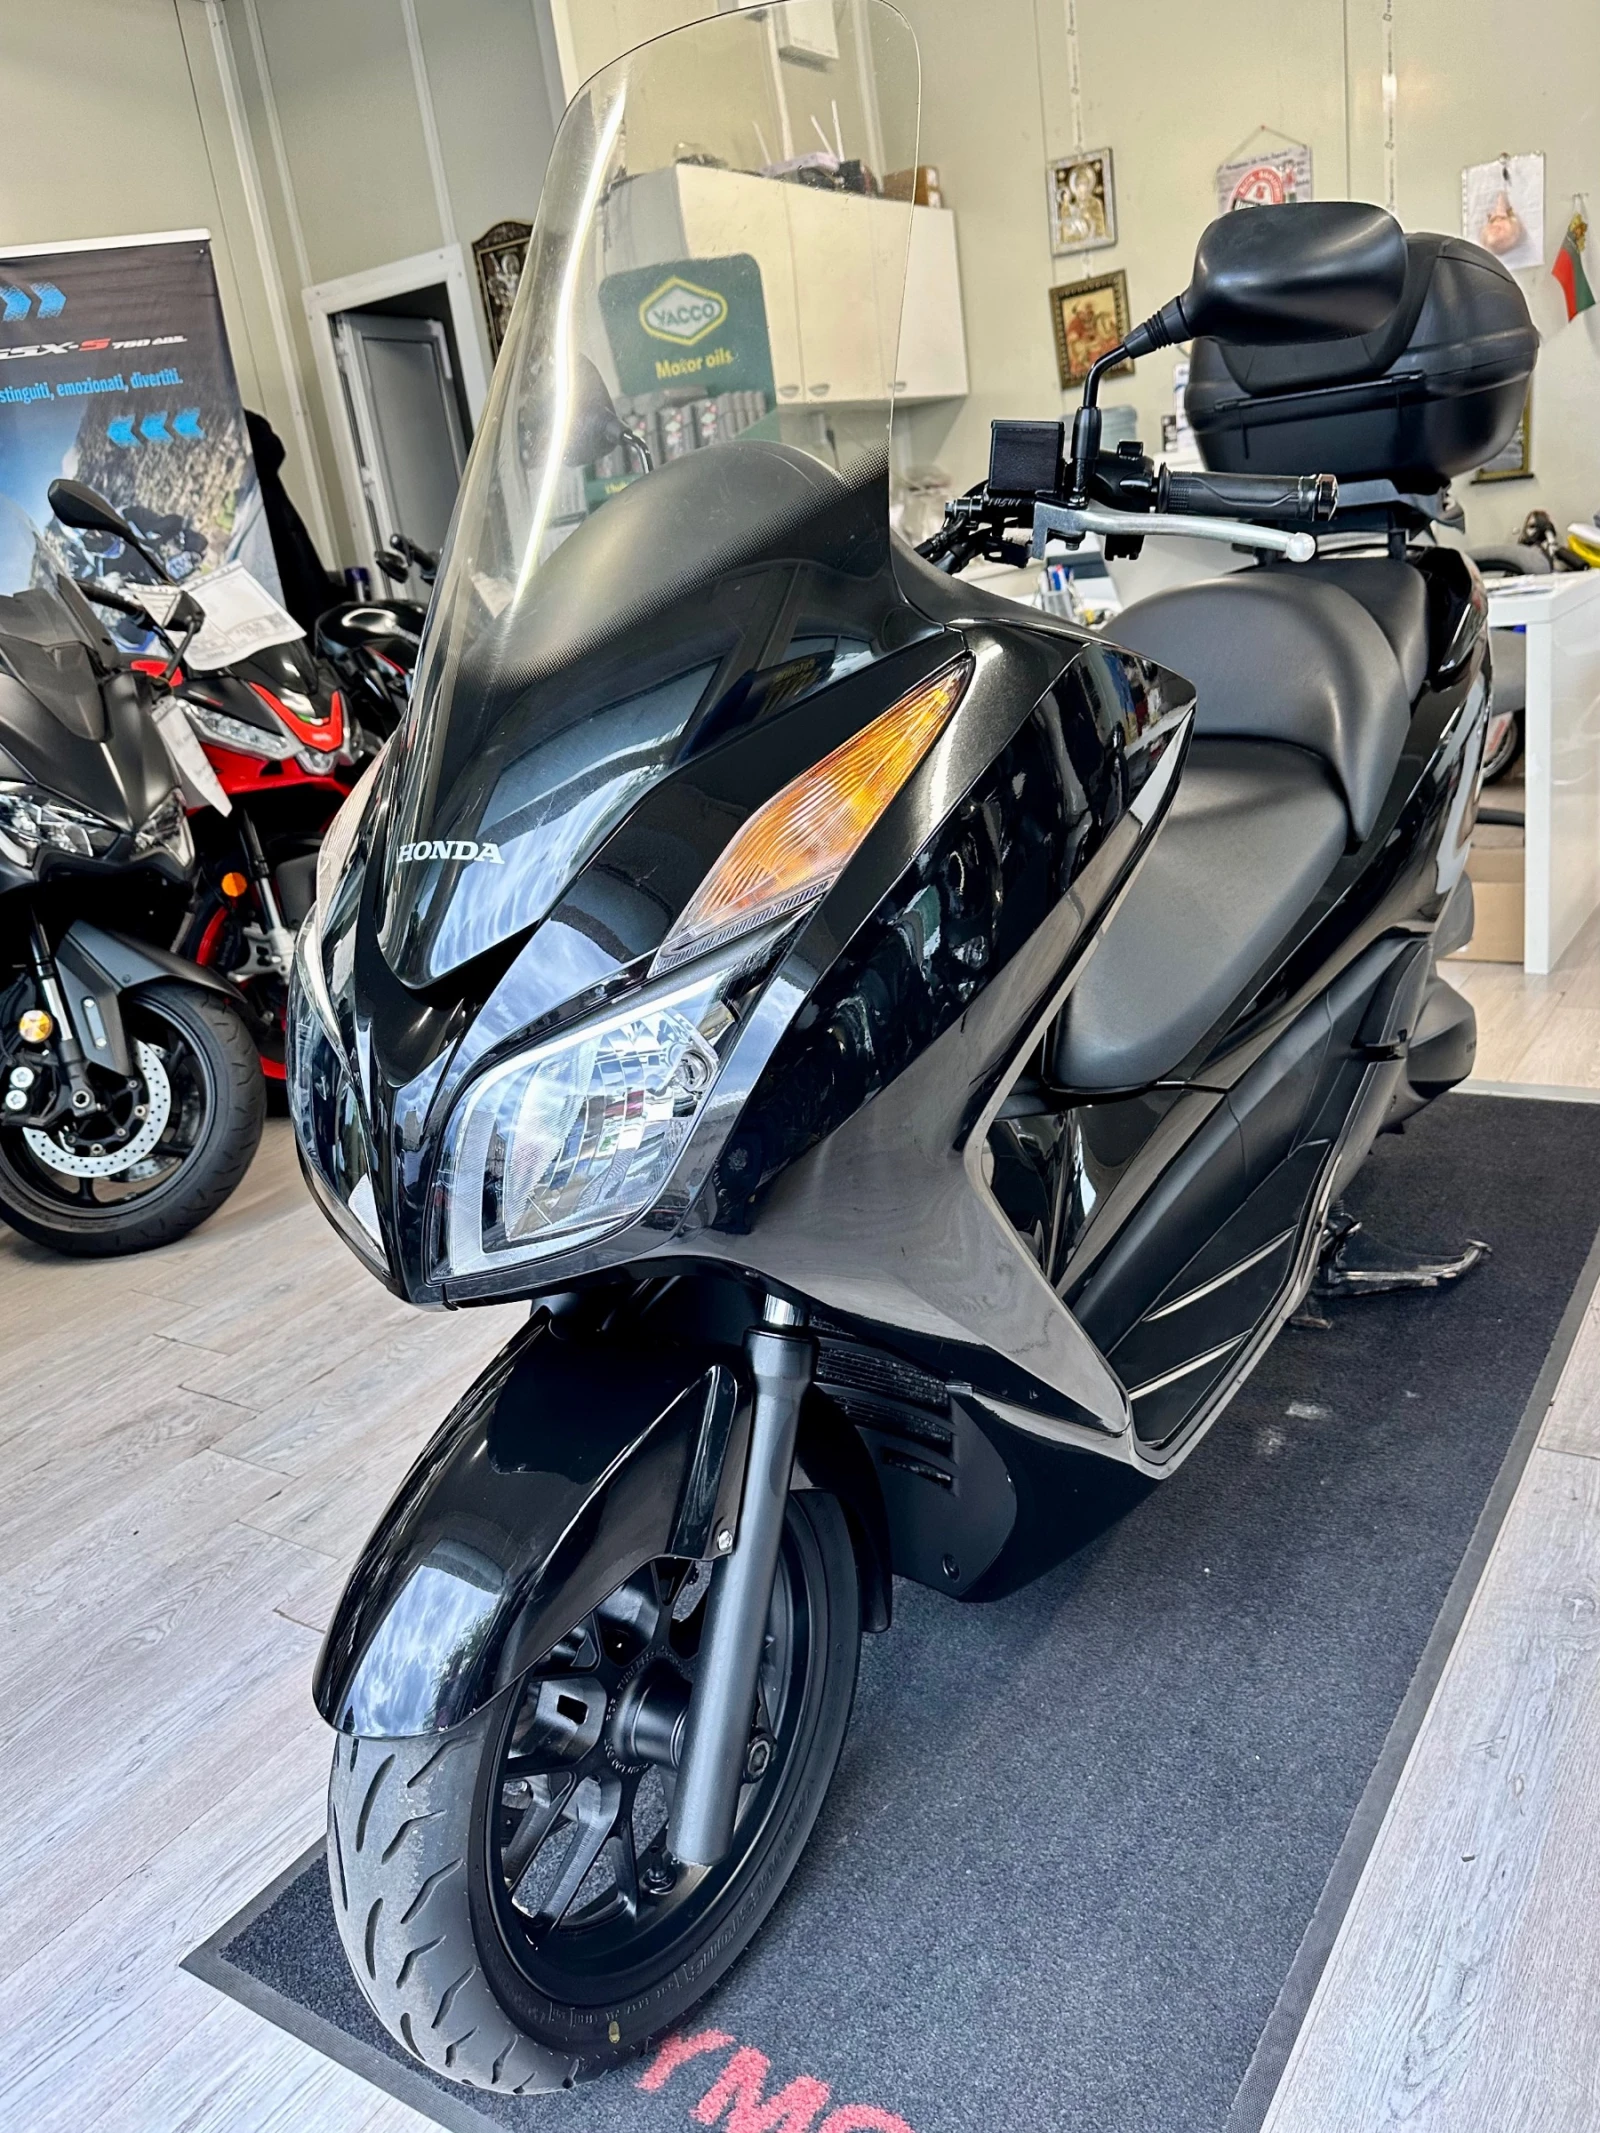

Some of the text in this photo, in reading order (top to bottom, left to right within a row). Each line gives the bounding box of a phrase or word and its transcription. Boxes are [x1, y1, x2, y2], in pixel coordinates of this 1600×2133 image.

[653, 302, 715, 326] YACCO
[655, 347, 732, 379] Motor oils
[56, 373, 129, 397] emozionati,
[130, 367, 183, 390] divertiti.
[397, 840, 505, 865] HONDA
